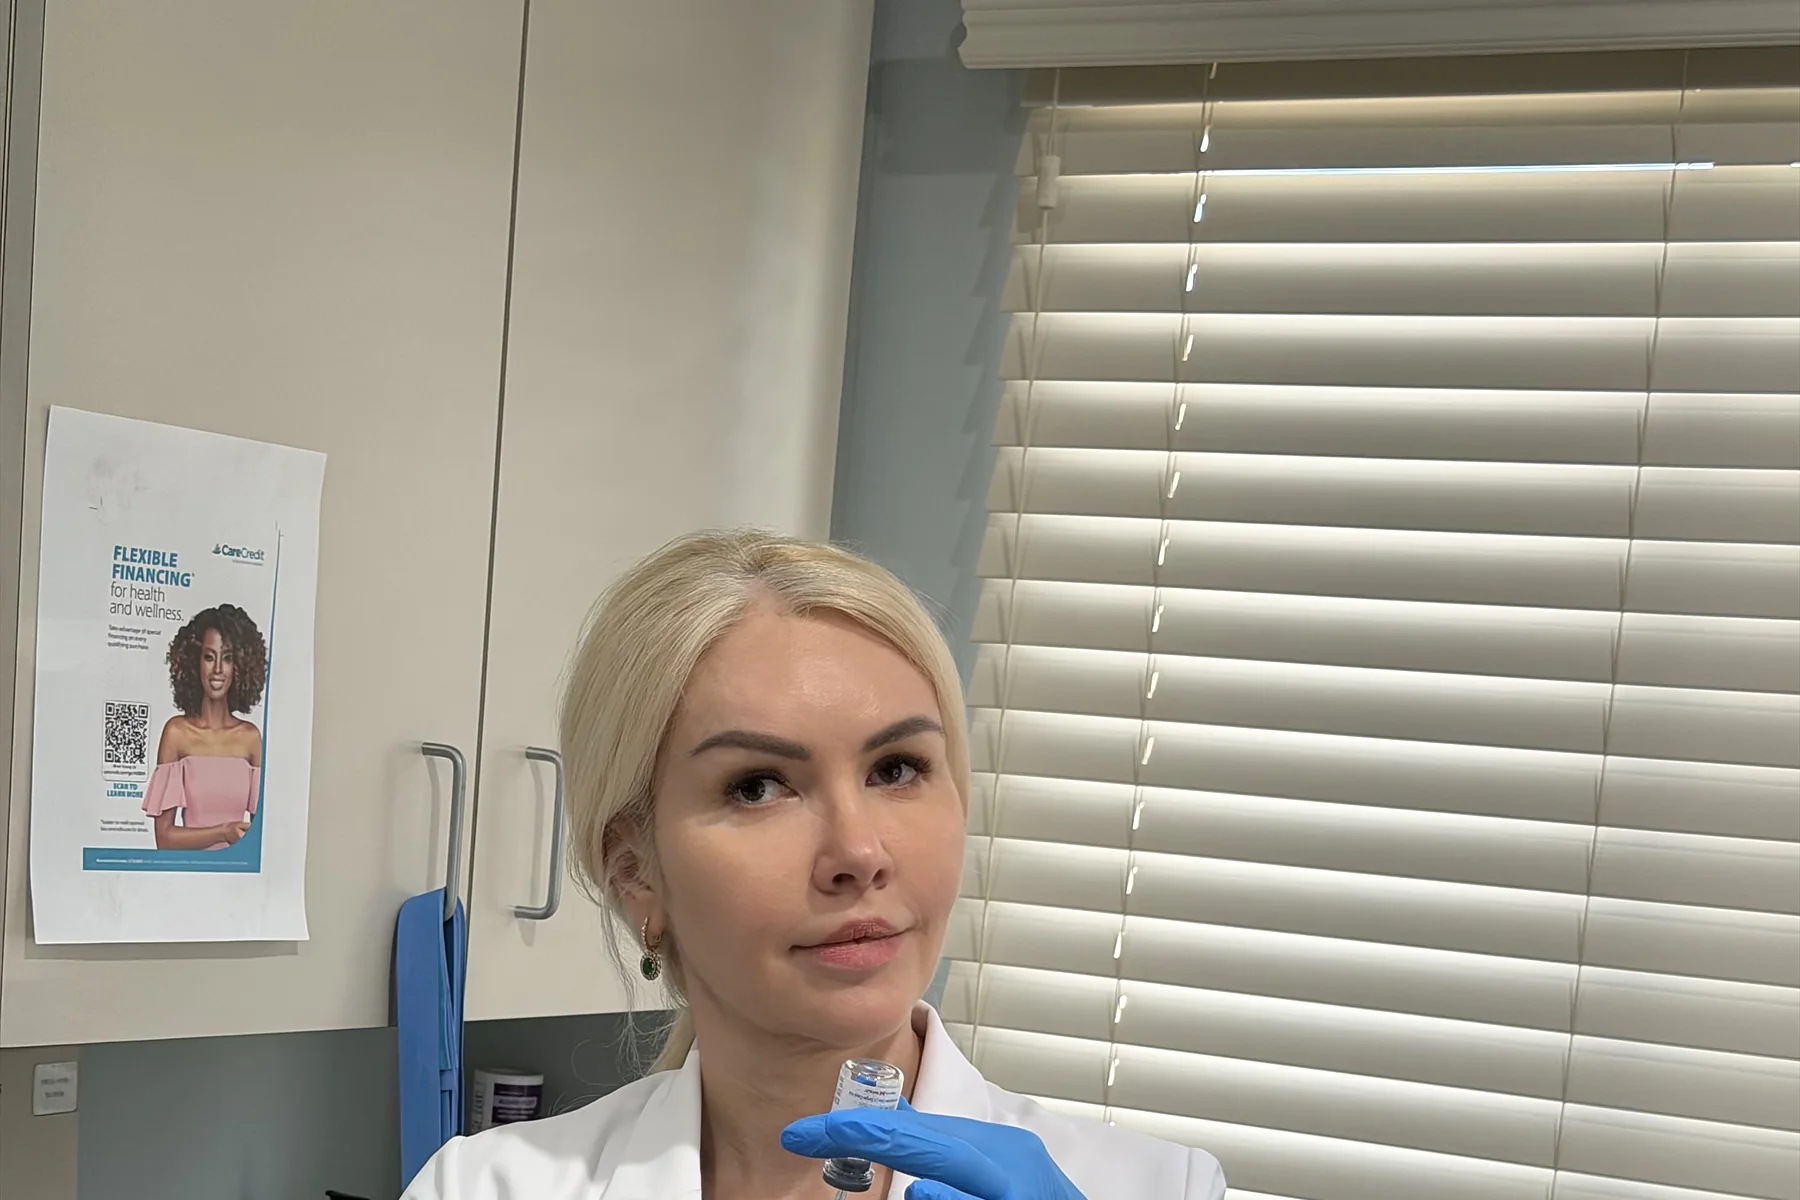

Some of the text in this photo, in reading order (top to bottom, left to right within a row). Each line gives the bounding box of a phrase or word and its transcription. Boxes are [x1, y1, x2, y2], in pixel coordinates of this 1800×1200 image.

[113, 545, 178, 568] FLEXIBLE
[221, 544, 264, 561] CareCredit
[110, 581, 165, 603] for health
[109, 600, 184, 622] and wellness.
